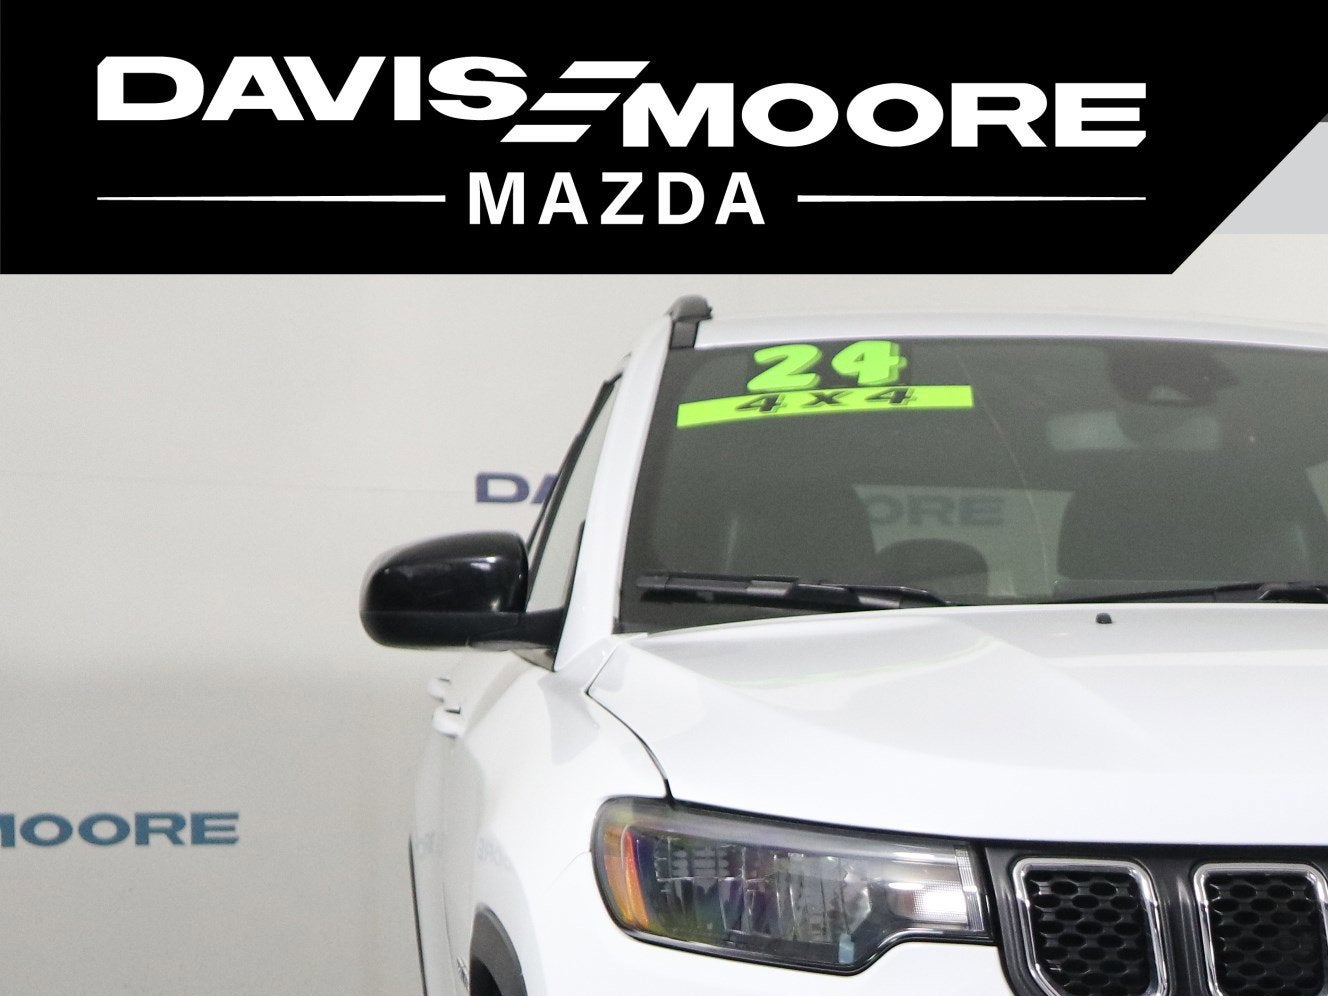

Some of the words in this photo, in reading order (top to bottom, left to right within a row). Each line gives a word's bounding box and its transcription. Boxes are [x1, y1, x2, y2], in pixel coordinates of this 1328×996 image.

[747, 340, 908, 393] 24
[866, 495, 1005, 526] ORE
[0, 811, 240, 849] OORE
